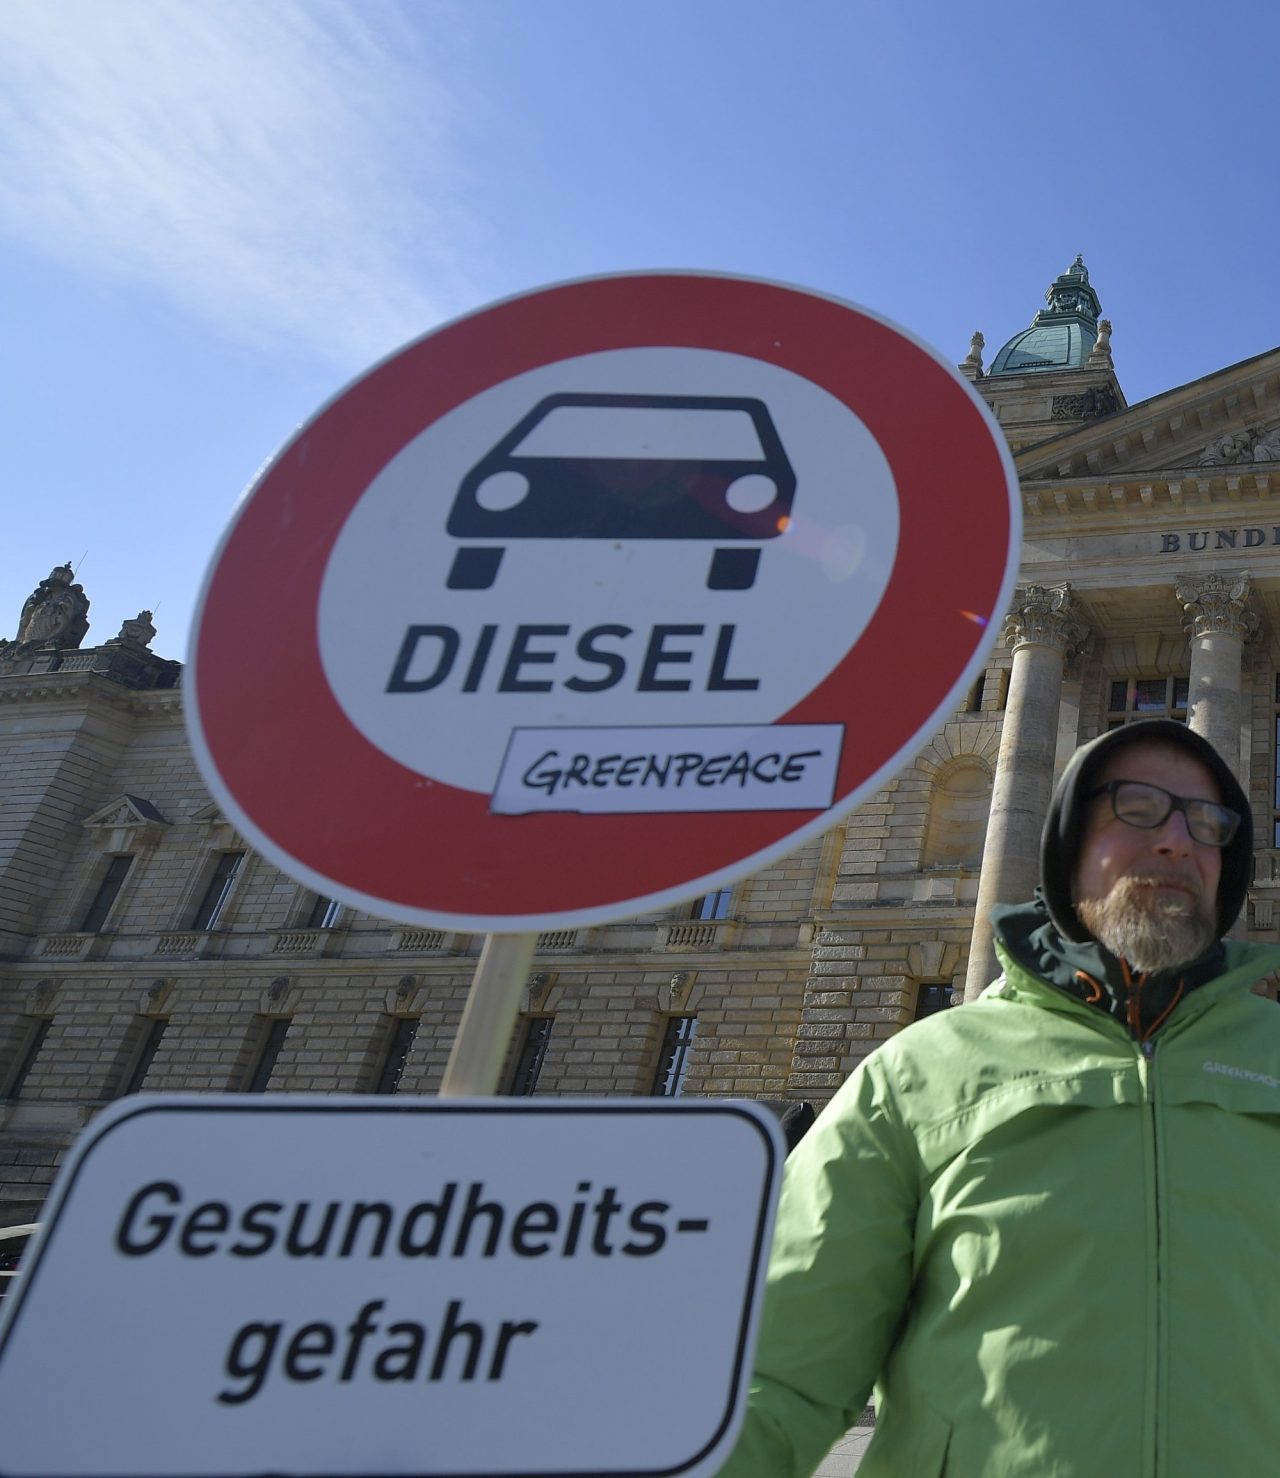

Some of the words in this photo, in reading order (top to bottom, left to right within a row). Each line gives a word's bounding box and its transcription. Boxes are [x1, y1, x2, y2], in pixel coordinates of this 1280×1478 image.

[386, 622, 761, 693] DIESEL
[522, 749, 821, 796] GREENPEACE
[115, 1181, 710, 1258] Gesundheits-
[216, 1300, 538, 1405] gefahr
